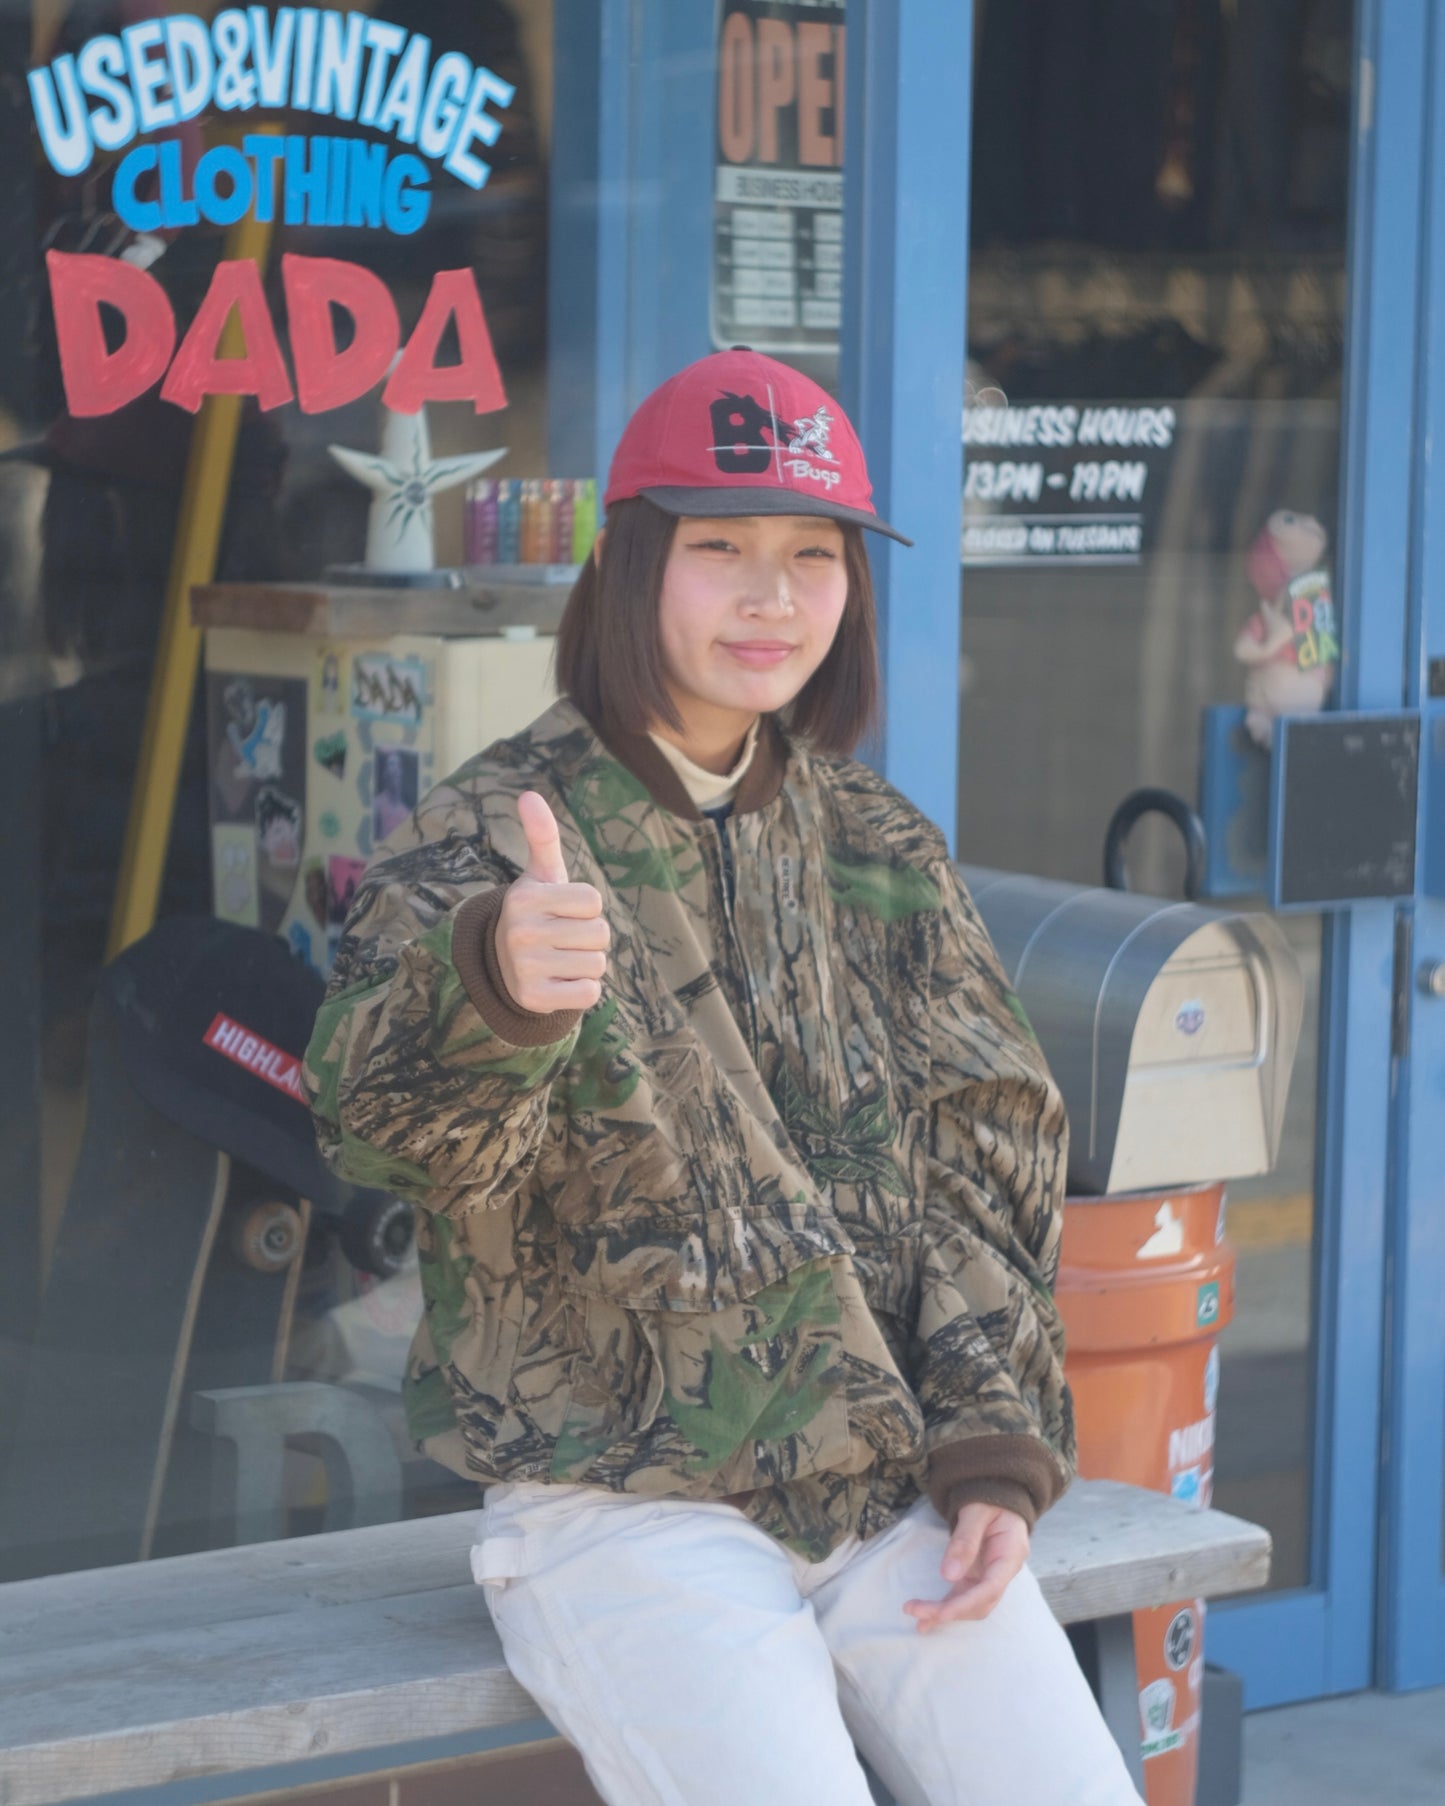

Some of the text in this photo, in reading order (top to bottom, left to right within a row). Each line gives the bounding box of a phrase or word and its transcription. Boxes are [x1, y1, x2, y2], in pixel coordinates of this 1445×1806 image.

[27, 4, 517, 190] USED&VINTAGE
[719, 11, 845, 165] OPE
[112, 135, 432, 235] CLOTHING
[735, 175, 800, 201] BUSINESS
[46, 249, 509, 418] DADA
[962, 406, 1175, 447] USINESS HOURS
[783, 459, 842, 491] Bugs
[964, 461, 1043, 502] 13PM
[1070, 460, 1146, 502] 19PM
